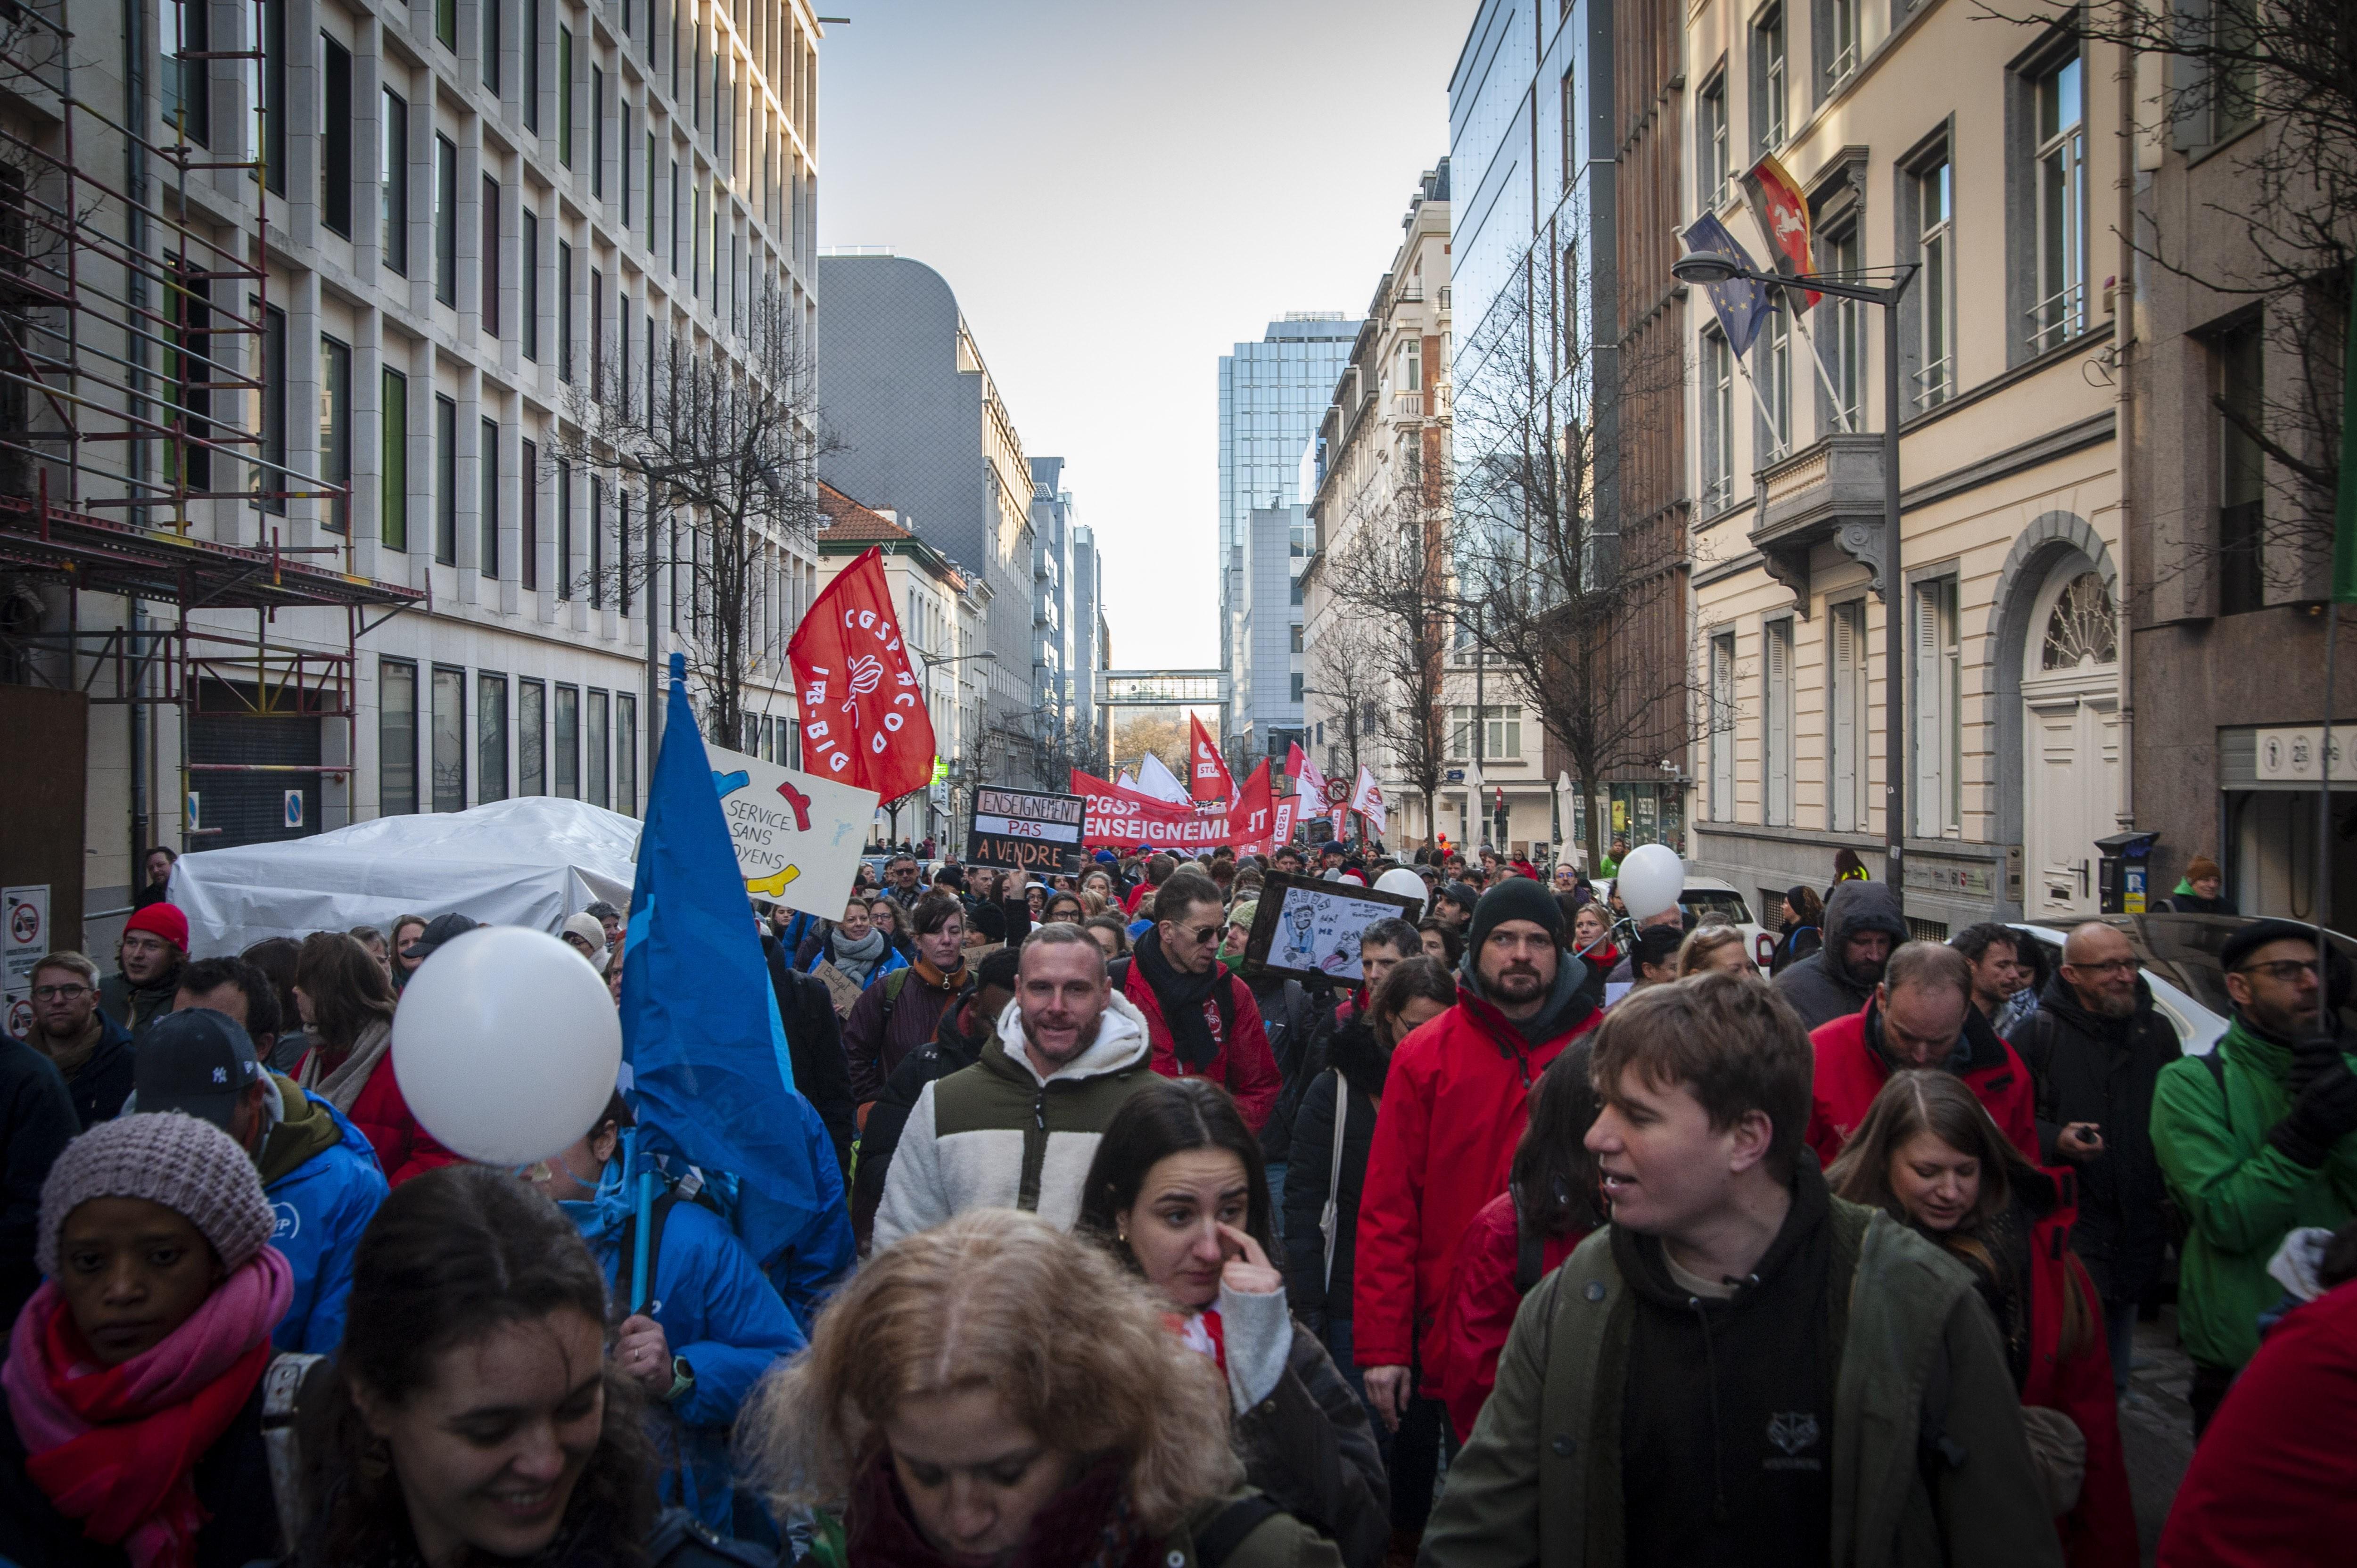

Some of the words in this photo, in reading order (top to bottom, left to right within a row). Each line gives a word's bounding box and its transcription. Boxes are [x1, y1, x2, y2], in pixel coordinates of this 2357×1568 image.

[983, 792, 1078, 821] ENSEIGNEMENT
[1085, 794, 1141, 816] CGSP
[730, 822, 772, 845] SANS
[1007, 820, 1042, 837] PAS
[977, 839, 989, 859] A
[996, 840, 1062, 868] VENDRE
